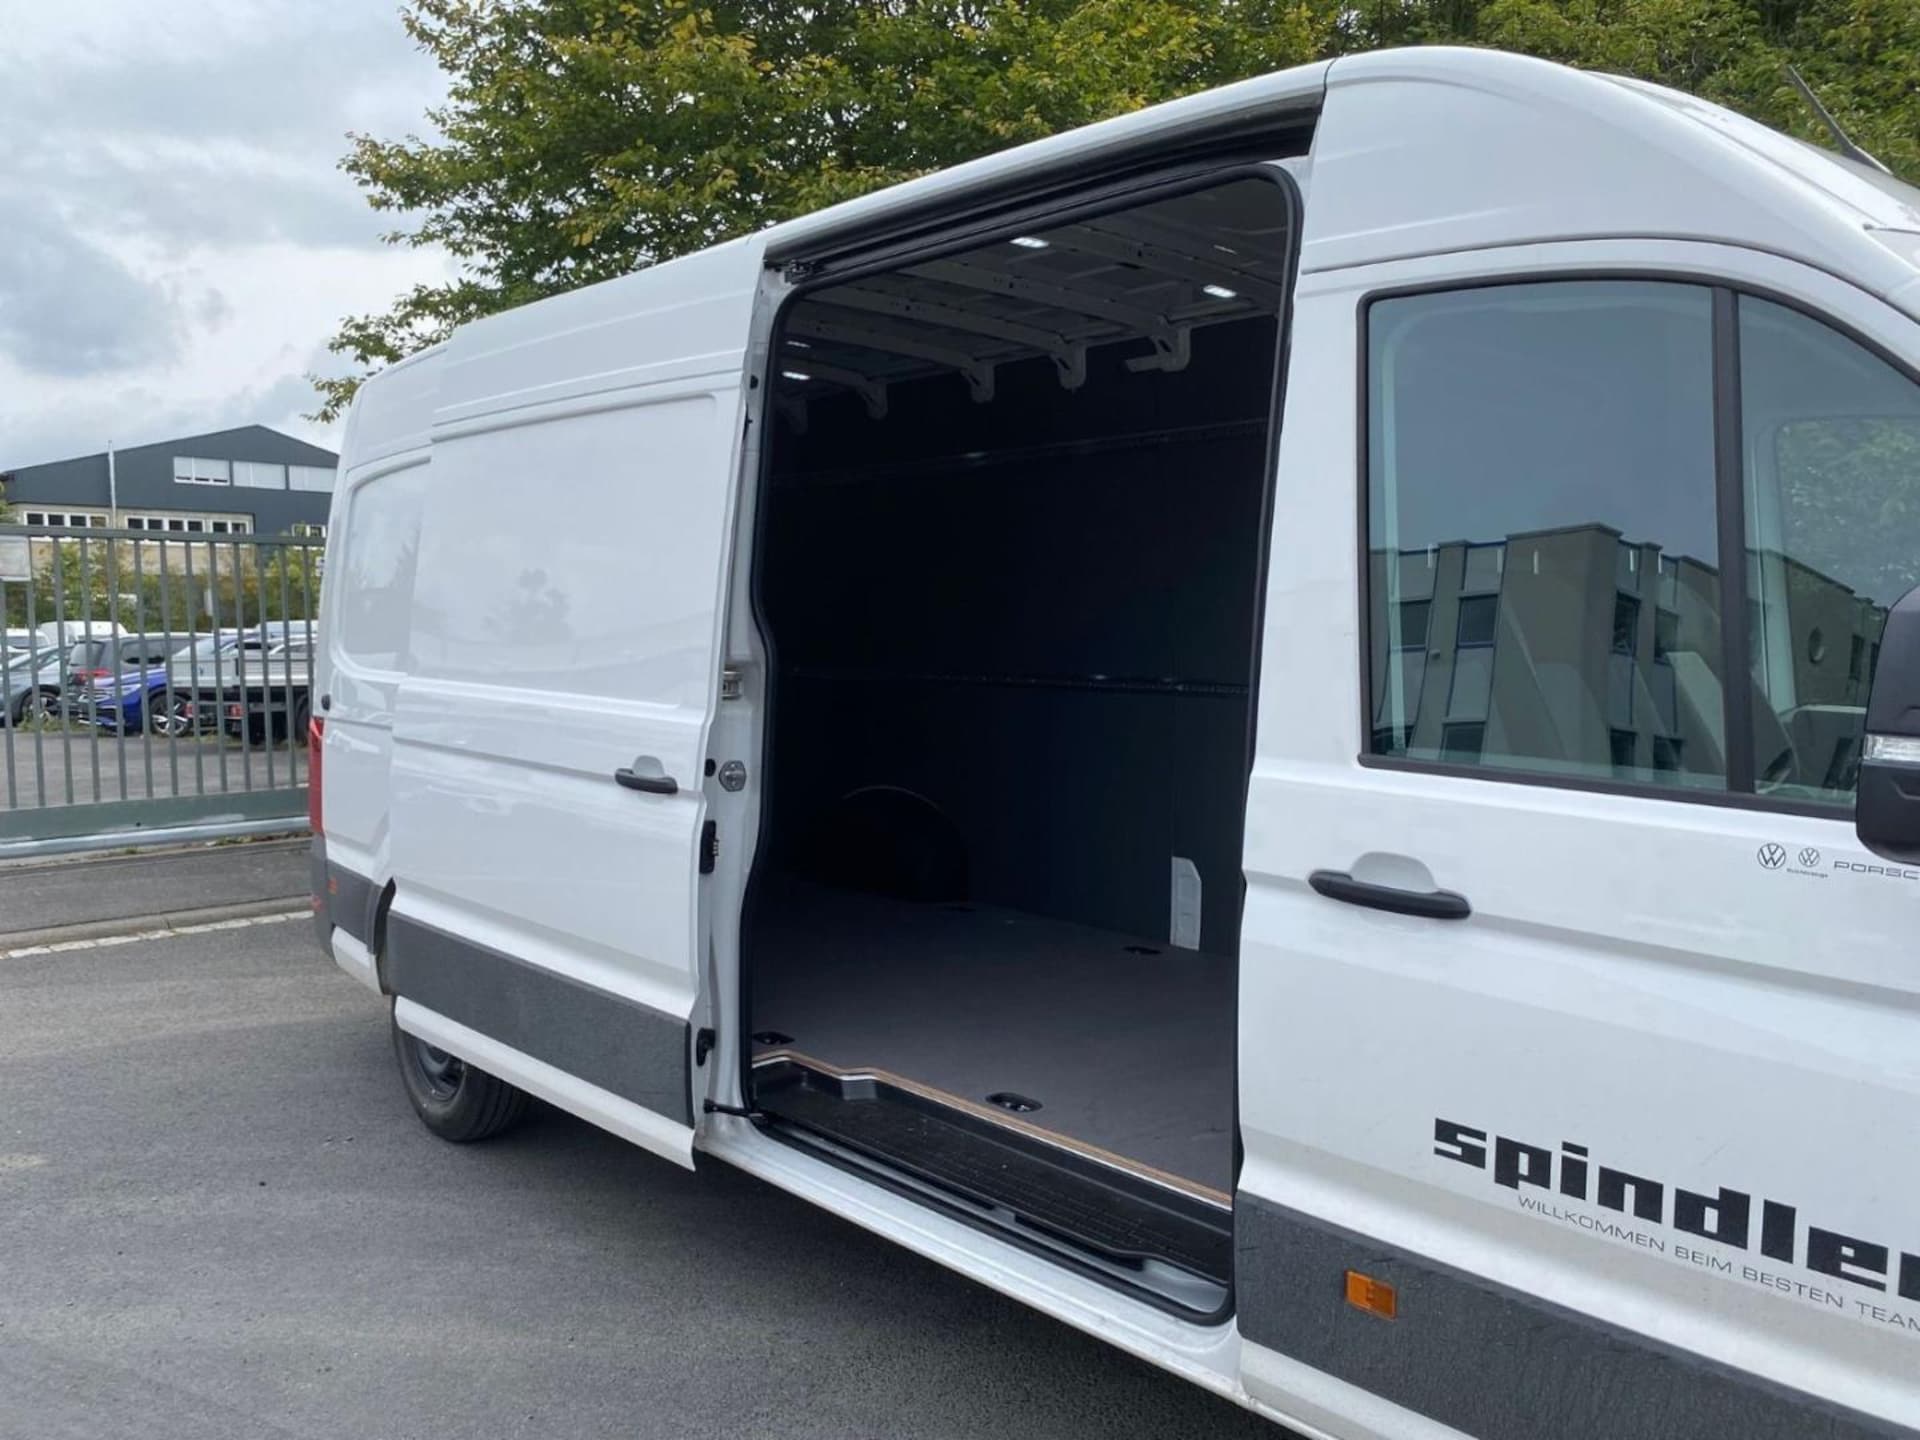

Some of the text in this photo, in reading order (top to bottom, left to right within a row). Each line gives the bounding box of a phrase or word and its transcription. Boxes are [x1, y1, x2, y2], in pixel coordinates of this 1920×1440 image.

[1517, 1194, 1665, 1252] WILLKOMMEN
[1674, 1246, 1733, 1274] BEIM
[1742, 1265, 1844, 1309] BESTEN
